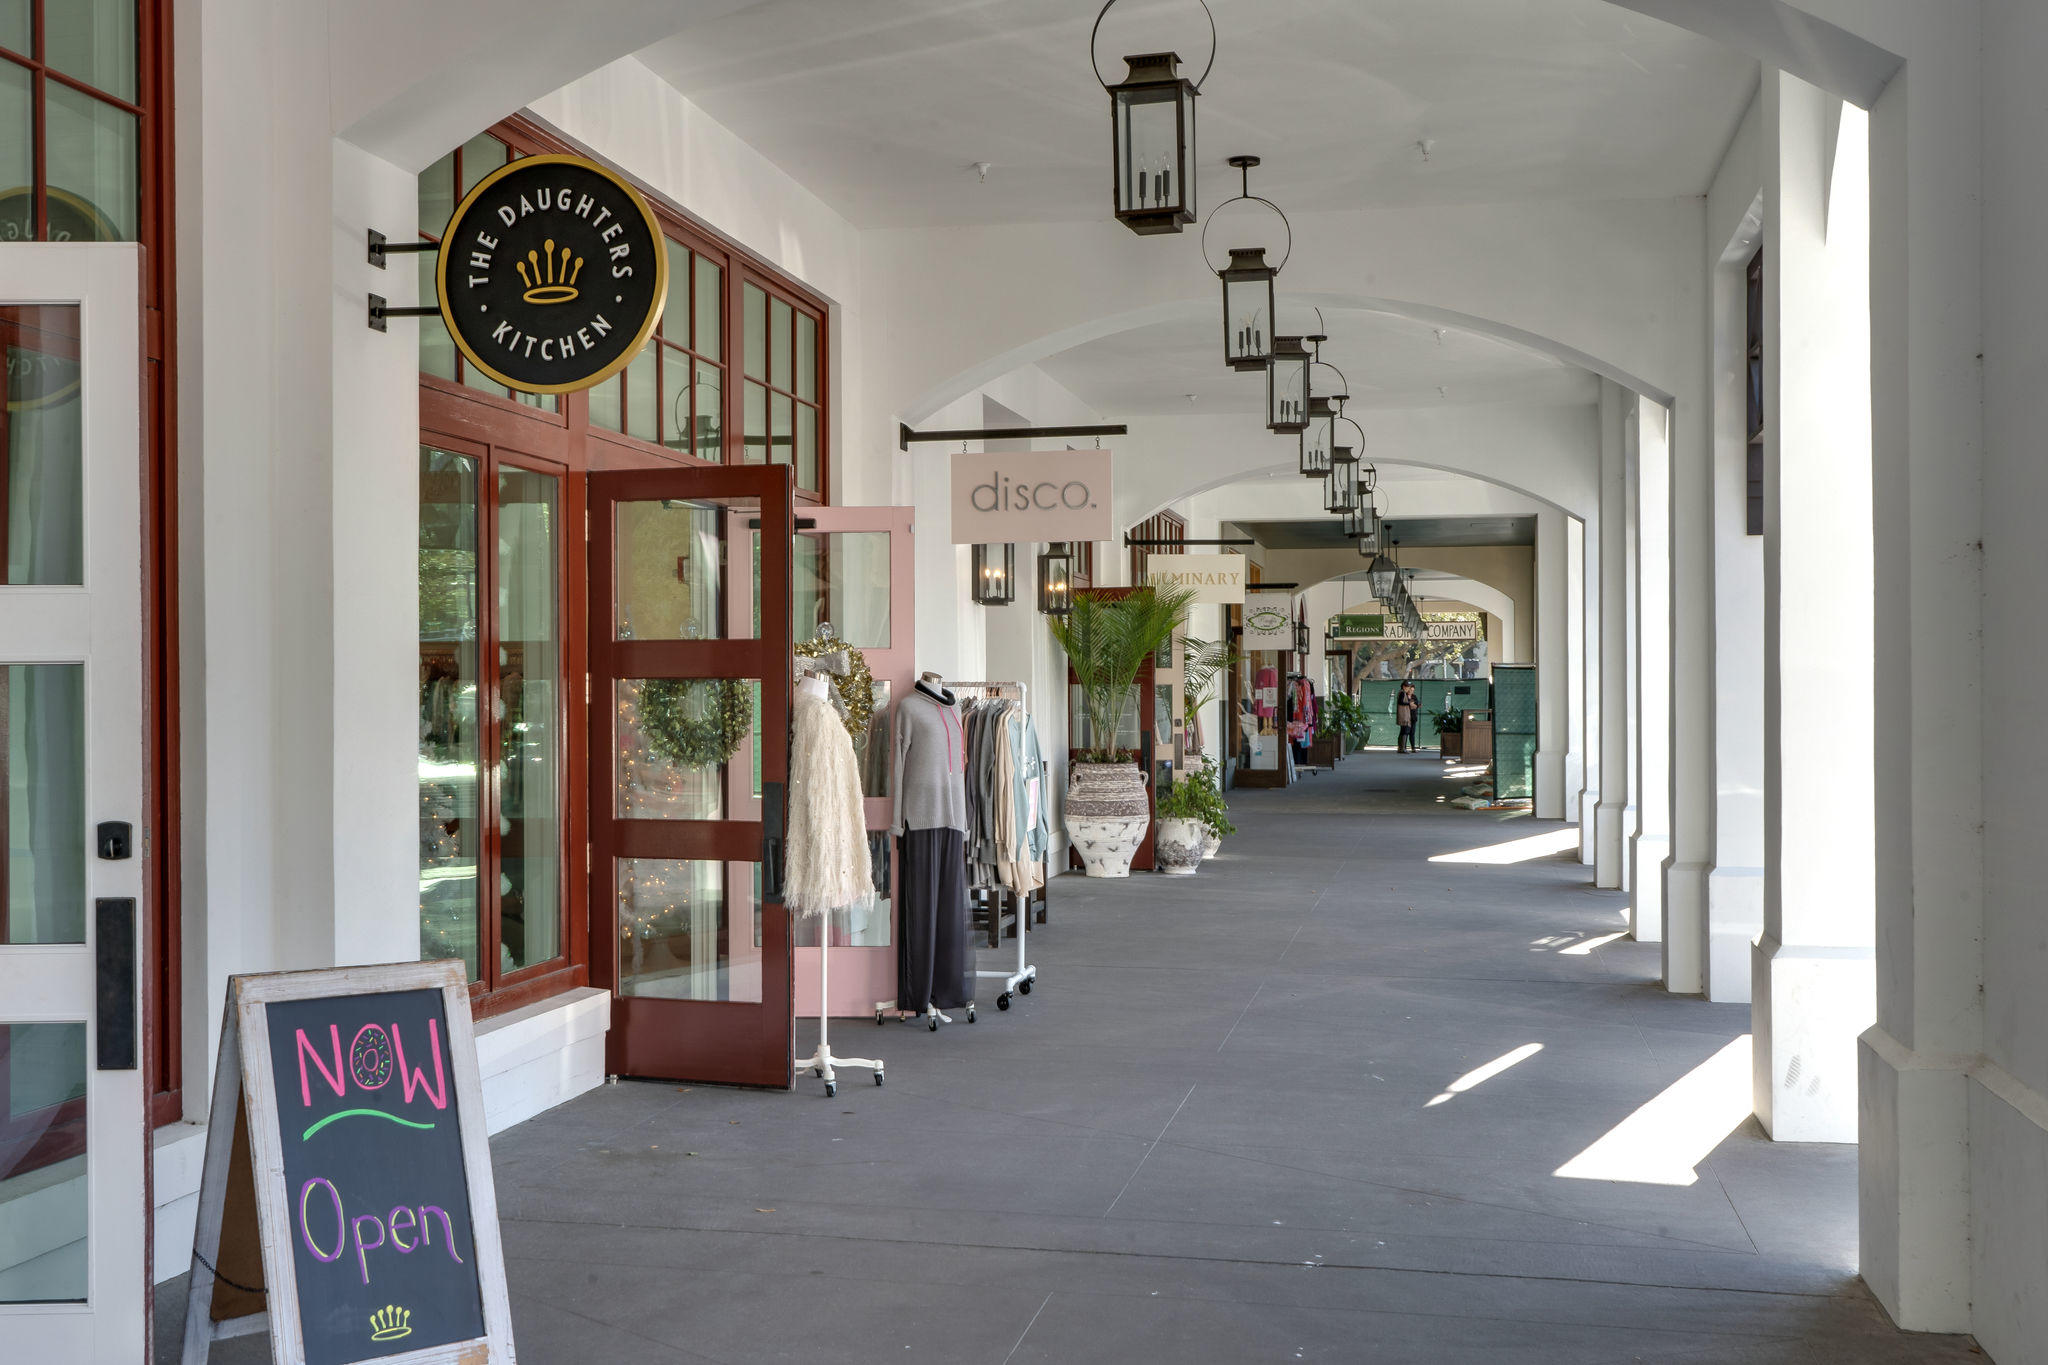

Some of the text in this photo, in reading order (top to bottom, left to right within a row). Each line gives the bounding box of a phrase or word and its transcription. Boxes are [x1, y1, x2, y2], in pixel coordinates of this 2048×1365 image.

[468, 188, 633, 289] THE DAUGHTERS
[492, 313, 613, 361] KITCHEN
[971, 471, 1097, 512] disco.
[1427, 624, 1473, 638] COMPANY
[295, 1018, 447, 1110] NOW
[300, 1177, 463, 1285] Open
